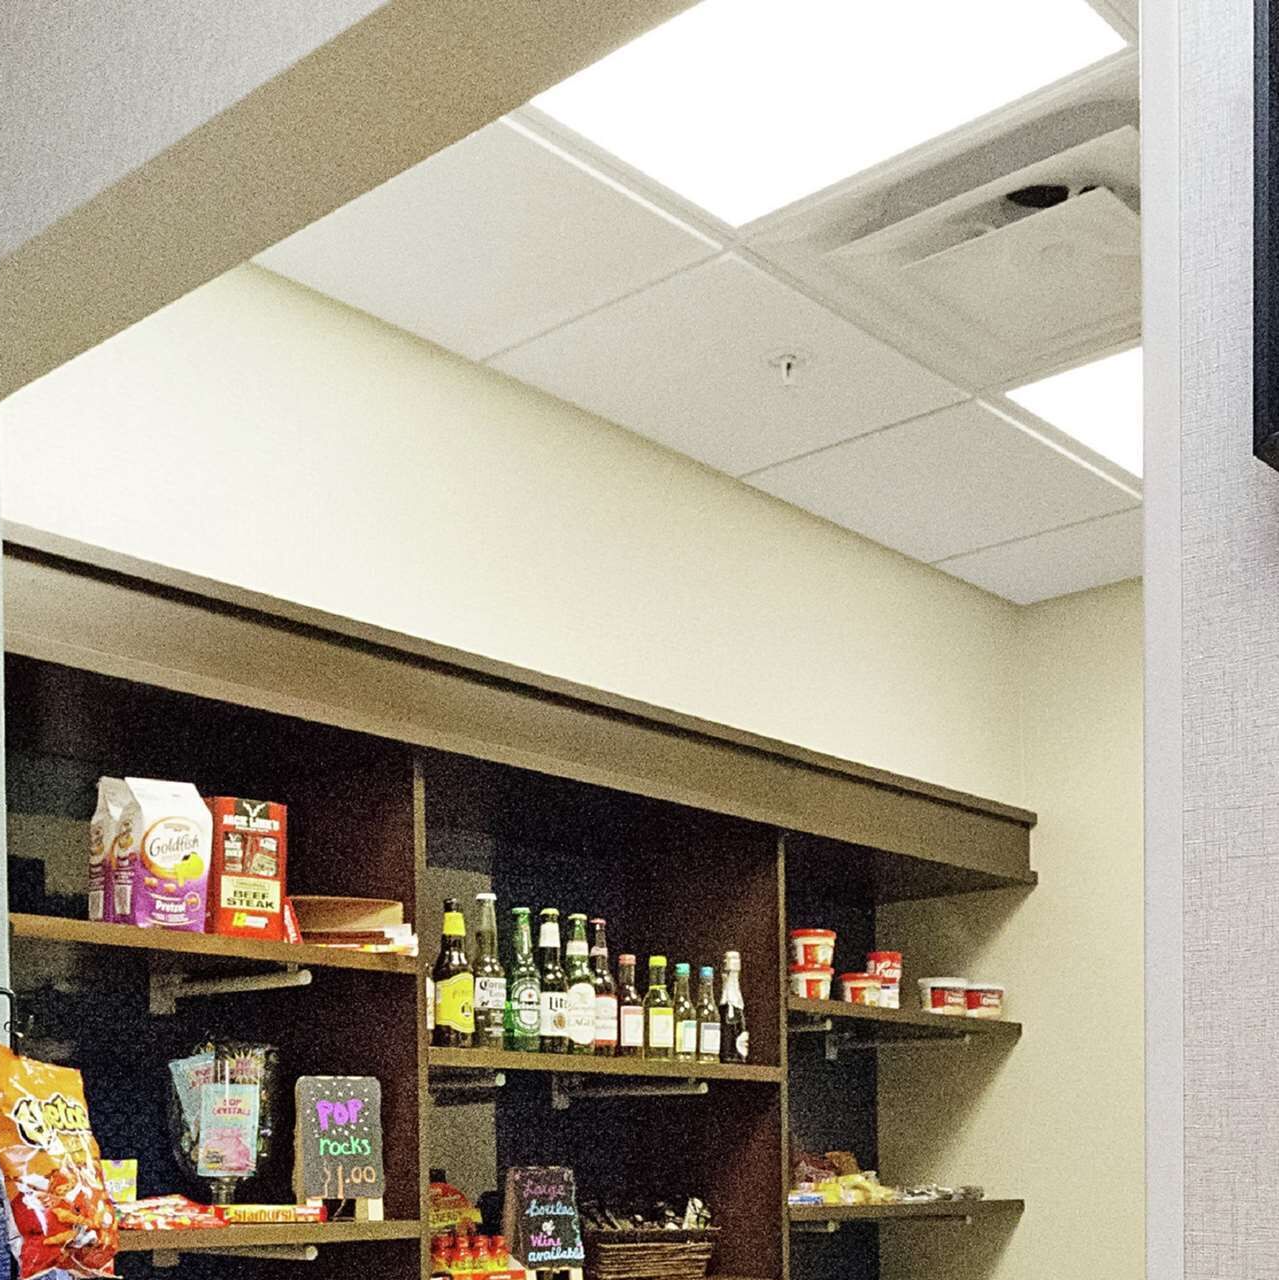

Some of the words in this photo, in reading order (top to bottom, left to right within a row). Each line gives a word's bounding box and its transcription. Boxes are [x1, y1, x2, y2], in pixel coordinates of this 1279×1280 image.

[233, 890, 269, 900] BEEF
[227, 899, 275, 909] STEAK
[316, 1099, 364, 1131] POP
[320, 1136, 371, 1156] rocks
